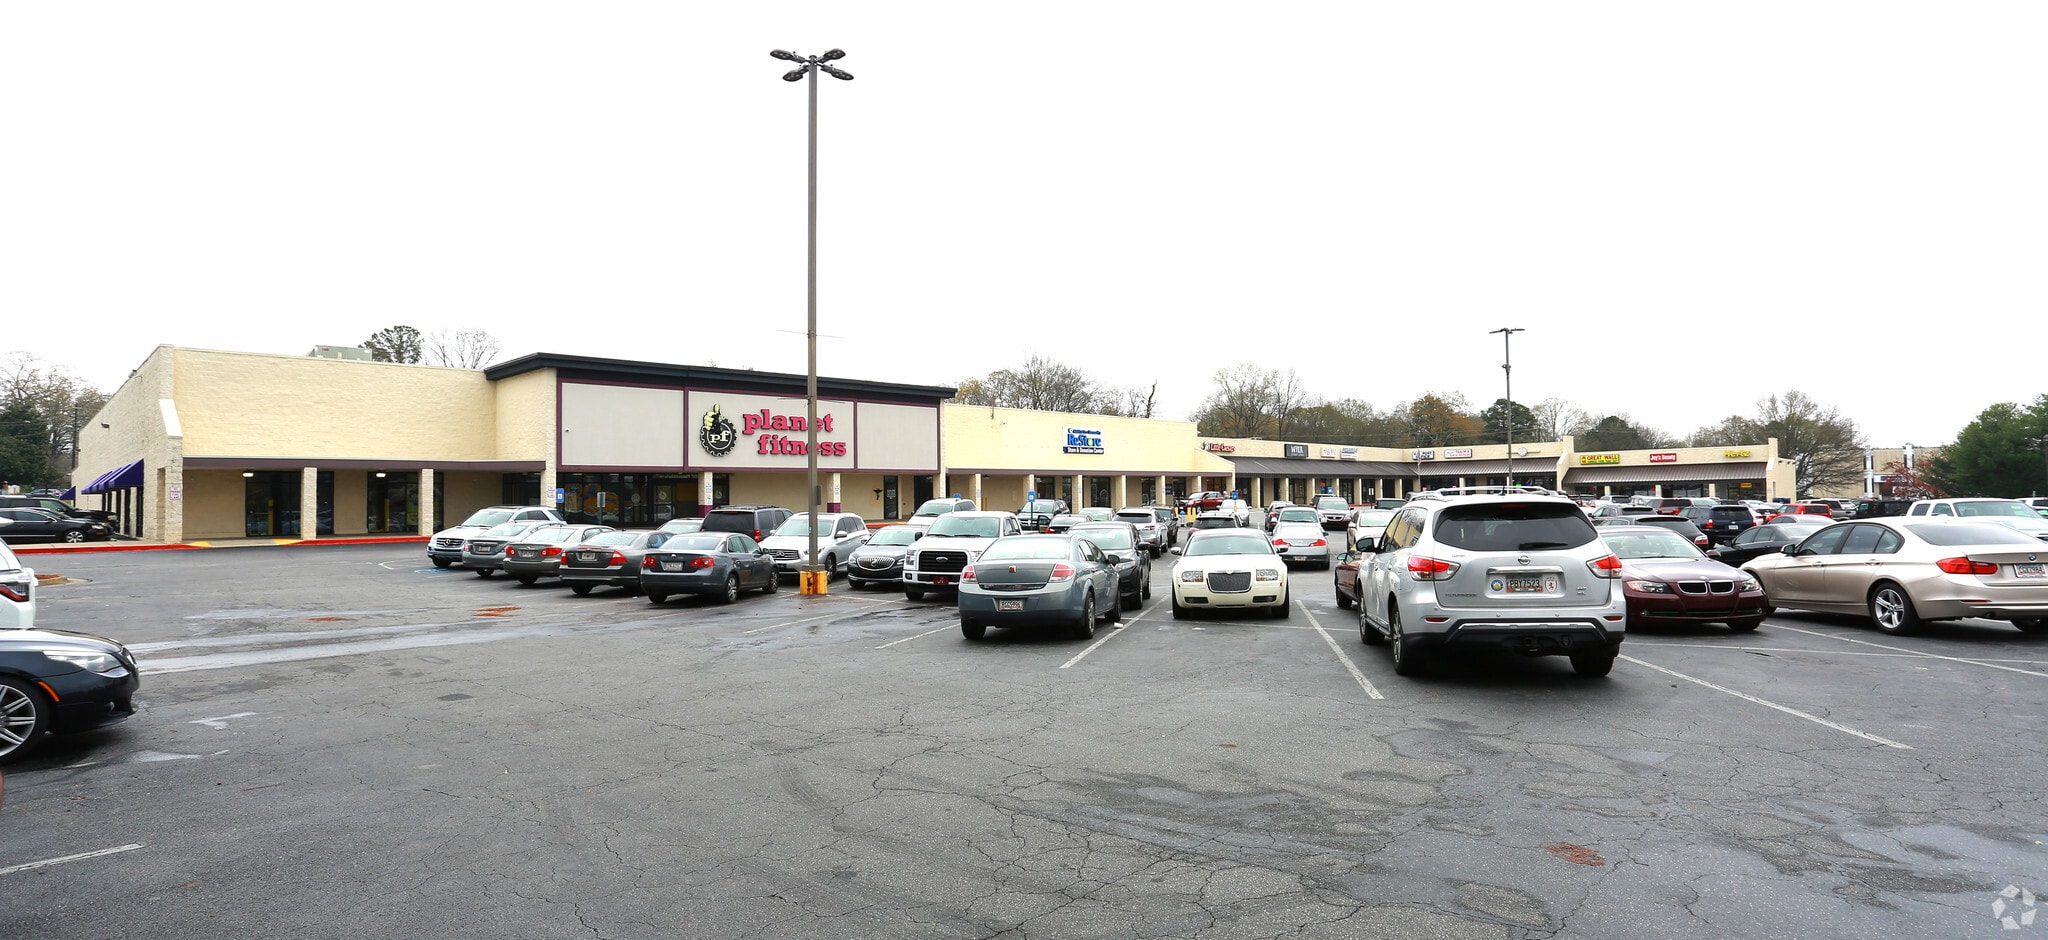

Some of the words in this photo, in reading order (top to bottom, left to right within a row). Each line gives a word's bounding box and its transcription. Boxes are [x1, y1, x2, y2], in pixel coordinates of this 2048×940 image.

[742, 409, 834, 434] planet
[709, 431, 730, 443] pf
[1067, 434, 1101, 446] ReStore
